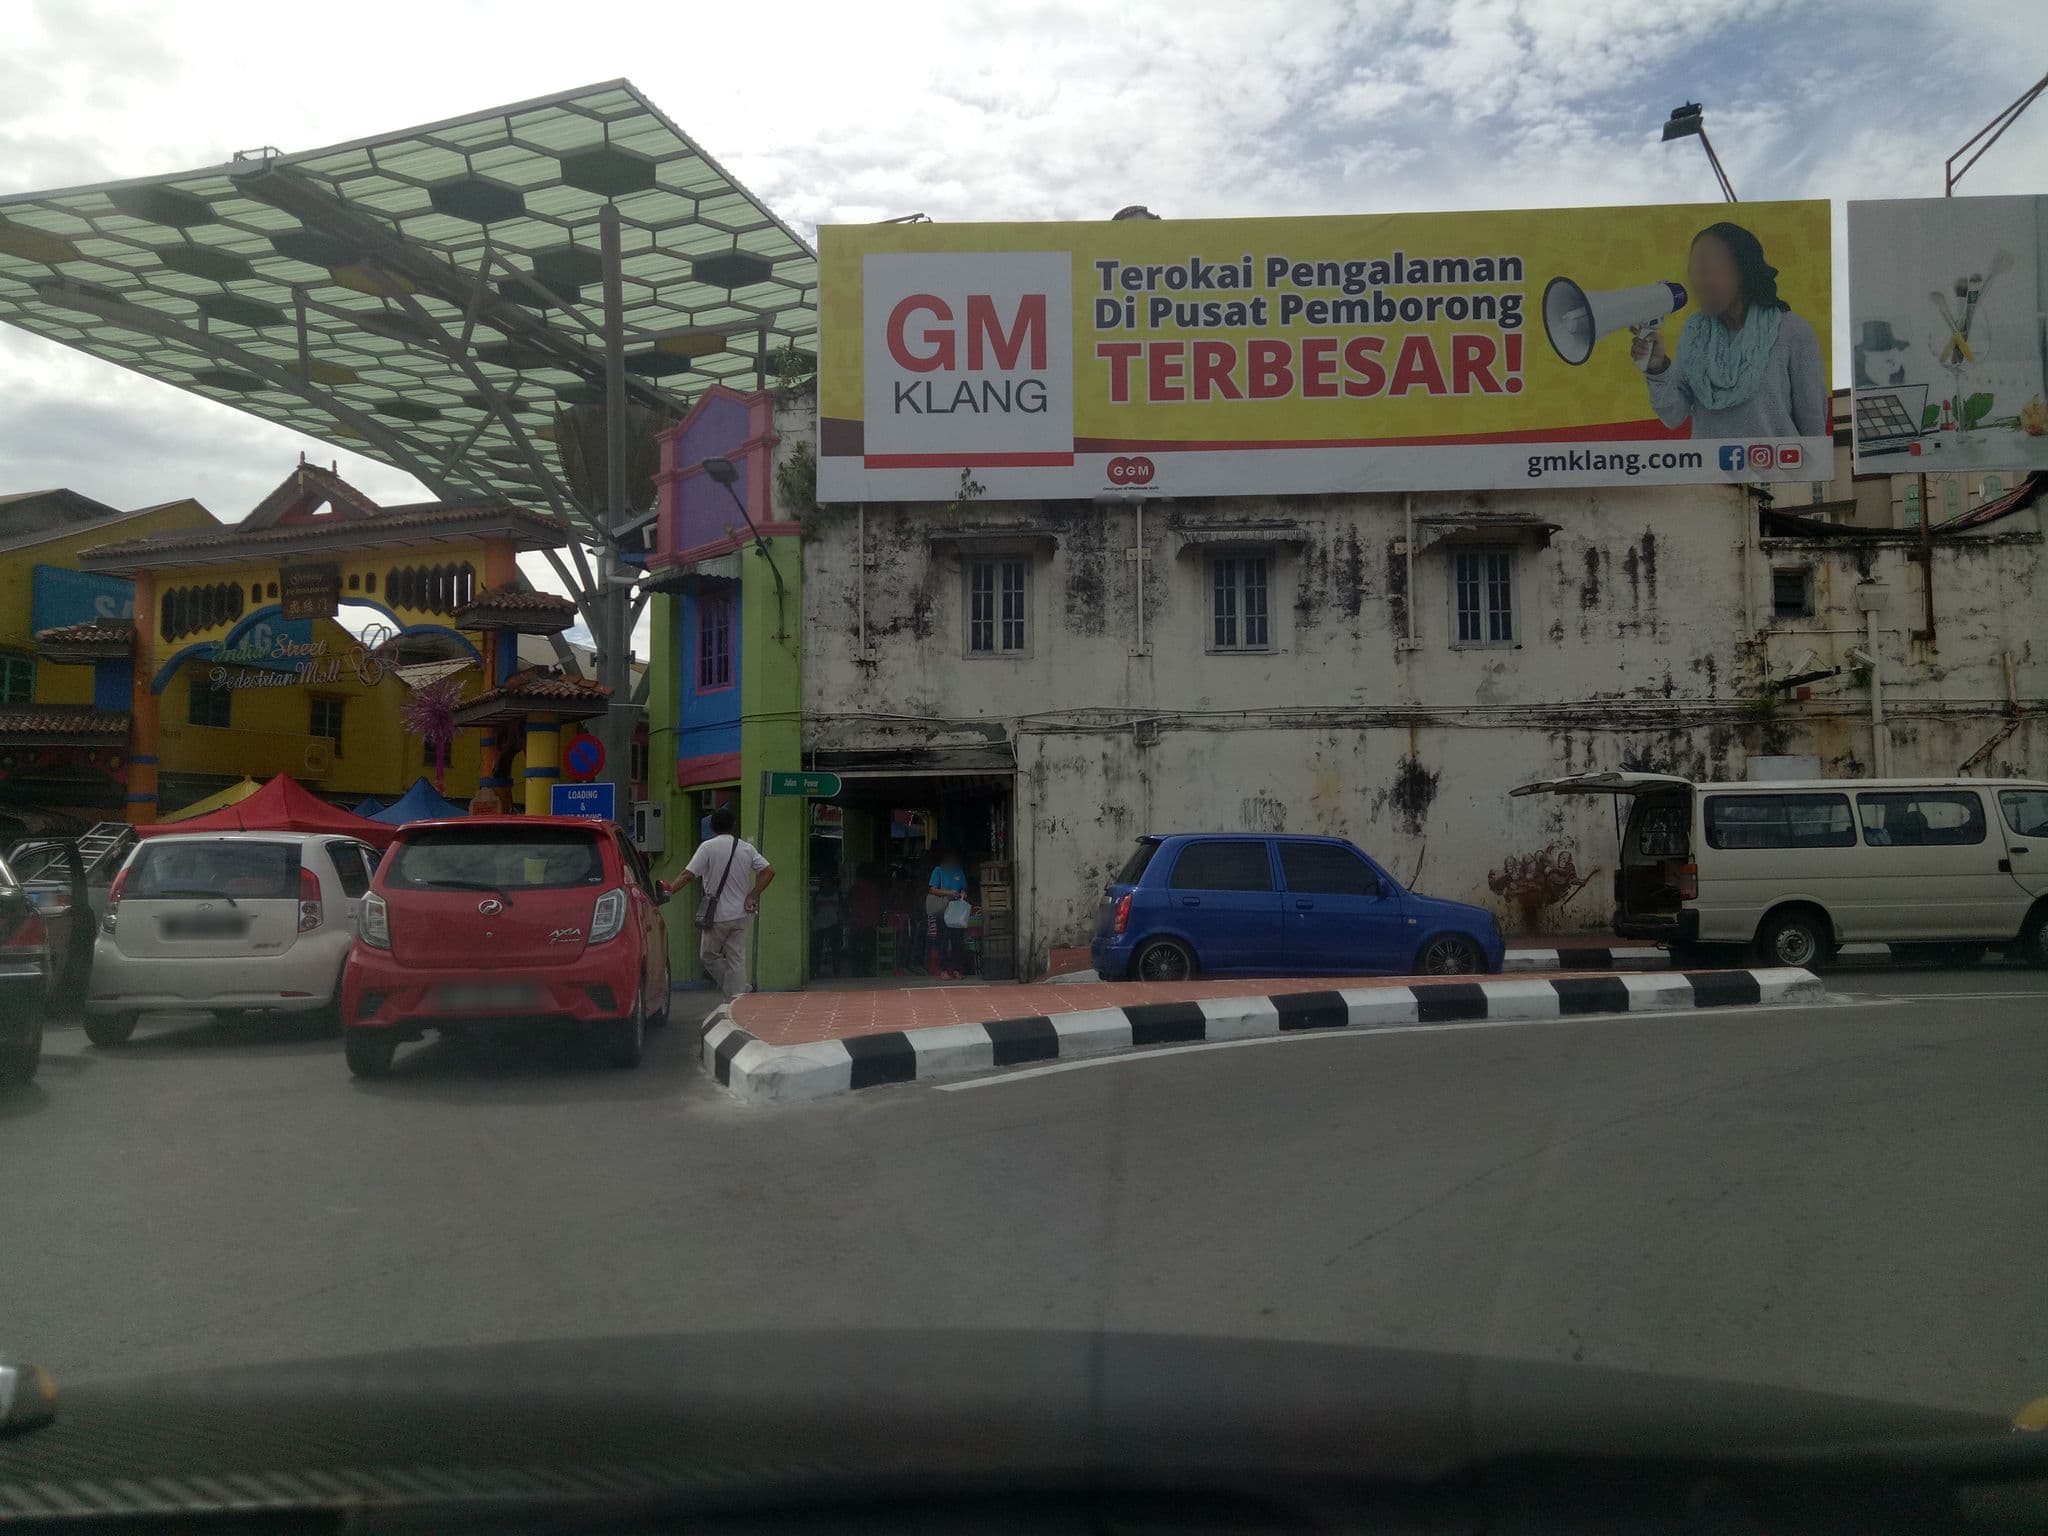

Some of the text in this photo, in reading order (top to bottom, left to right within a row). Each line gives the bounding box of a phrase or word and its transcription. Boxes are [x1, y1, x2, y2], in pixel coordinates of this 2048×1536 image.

[1096, 252, 1523, 297] Terokai Pengalaman
[1096, 290, 1523, 330] Di Pusat Pemborong
[888, 294, 1047, 373] GM
[1097, 333, 1523, 401] TERBESAR!
[894, 379, 1047, 414] KLANG
[1113, 465, 1149, 476] GGM
[1527, 449, 1703, 478] gmklang.com
[271, 633, 328, 658] Street
[210, 659, 340, 691] Pedestrian Mall
[567, 790, 598, 800] LOADING
